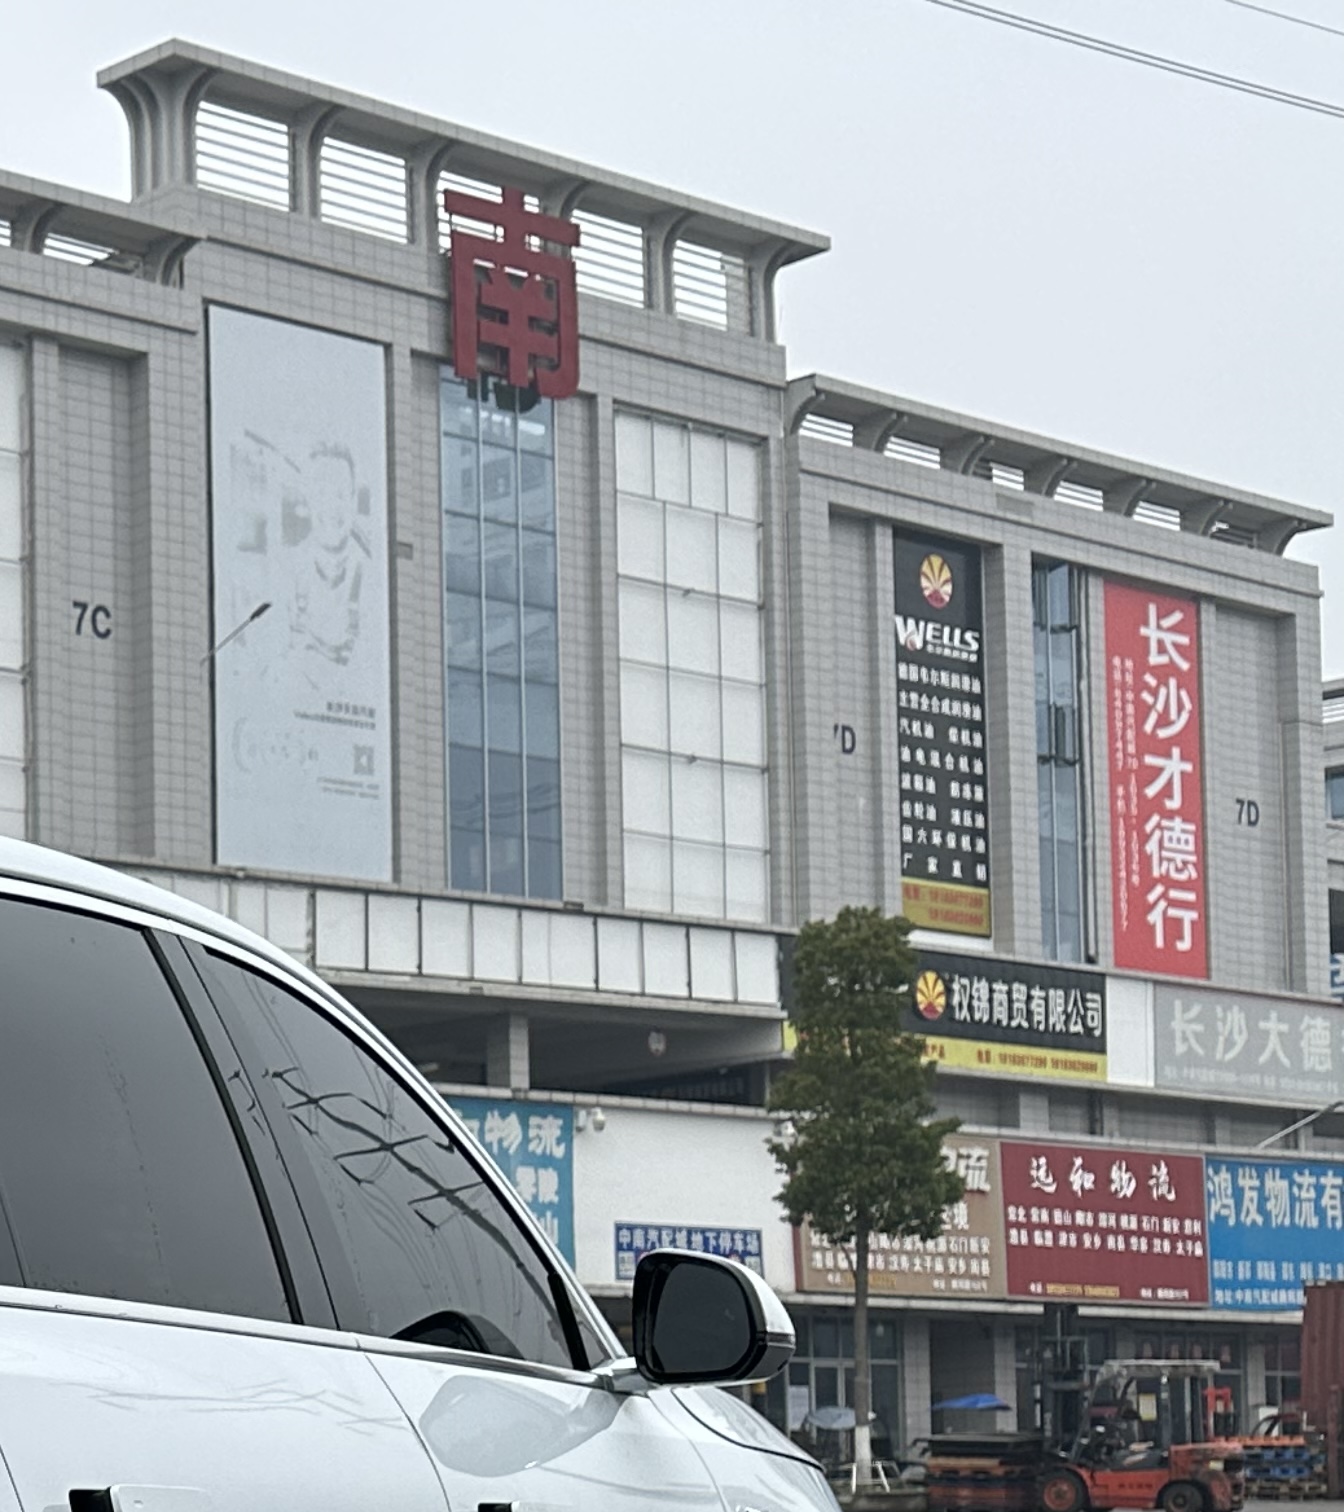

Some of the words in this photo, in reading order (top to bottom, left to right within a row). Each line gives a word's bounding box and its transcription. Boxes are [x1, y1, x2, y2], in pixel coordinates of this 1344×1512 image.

[443, 186, 580, 399] 南
[71, 600, 112, 640] 7C
[895, 614, 980, 652] WELLS
[1139, 602, 1199, 953] 长沙才德行
[1235, 798, 1260, 827] 7D
[951, 974, 1103, 1037] 权锦商贸有限公司
[1171, 999, 1344, 1073] 长沙大德
[1207, 1164, 1344, 1231] 鸿发物流有
[618, 1227, 760, 1255] 中南汽配城地下停车场
